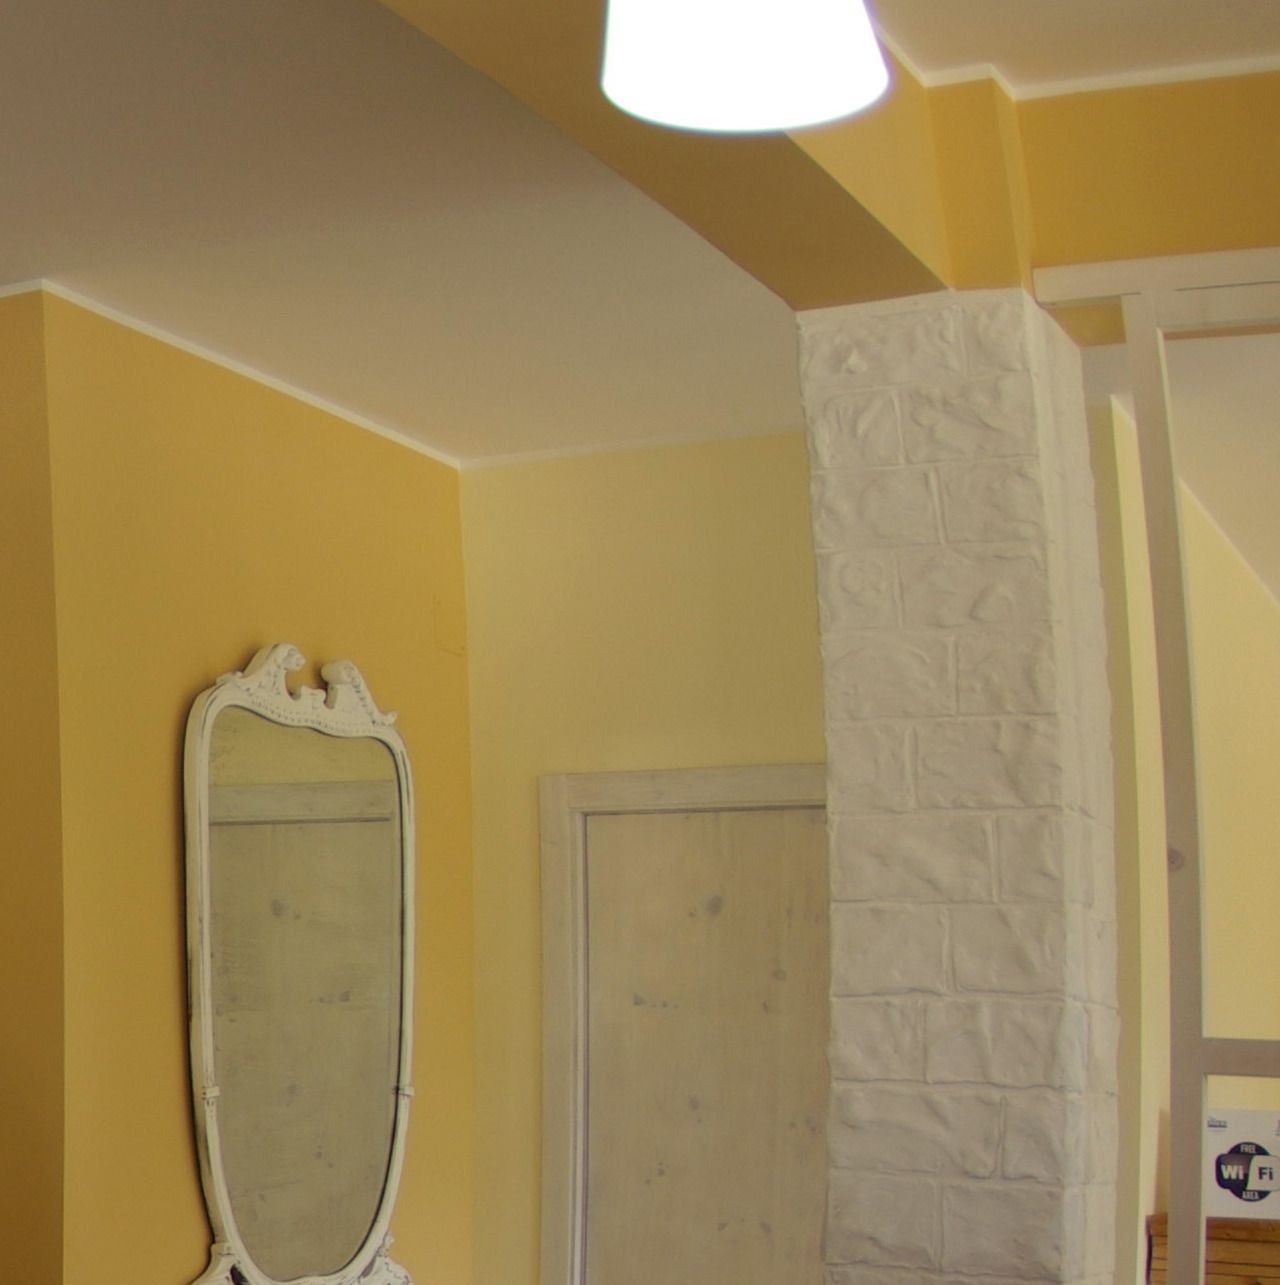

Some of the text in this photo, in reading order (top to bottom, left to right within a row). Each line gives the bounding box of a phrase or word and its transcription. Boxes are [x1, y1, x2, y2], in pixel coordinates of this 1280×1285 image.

[1240, 1144, 1256, 1153] FREE
[1221, 1164, 1274, 1181] Wi Fi
[1242, 1191, 1260, 1200] AREA
